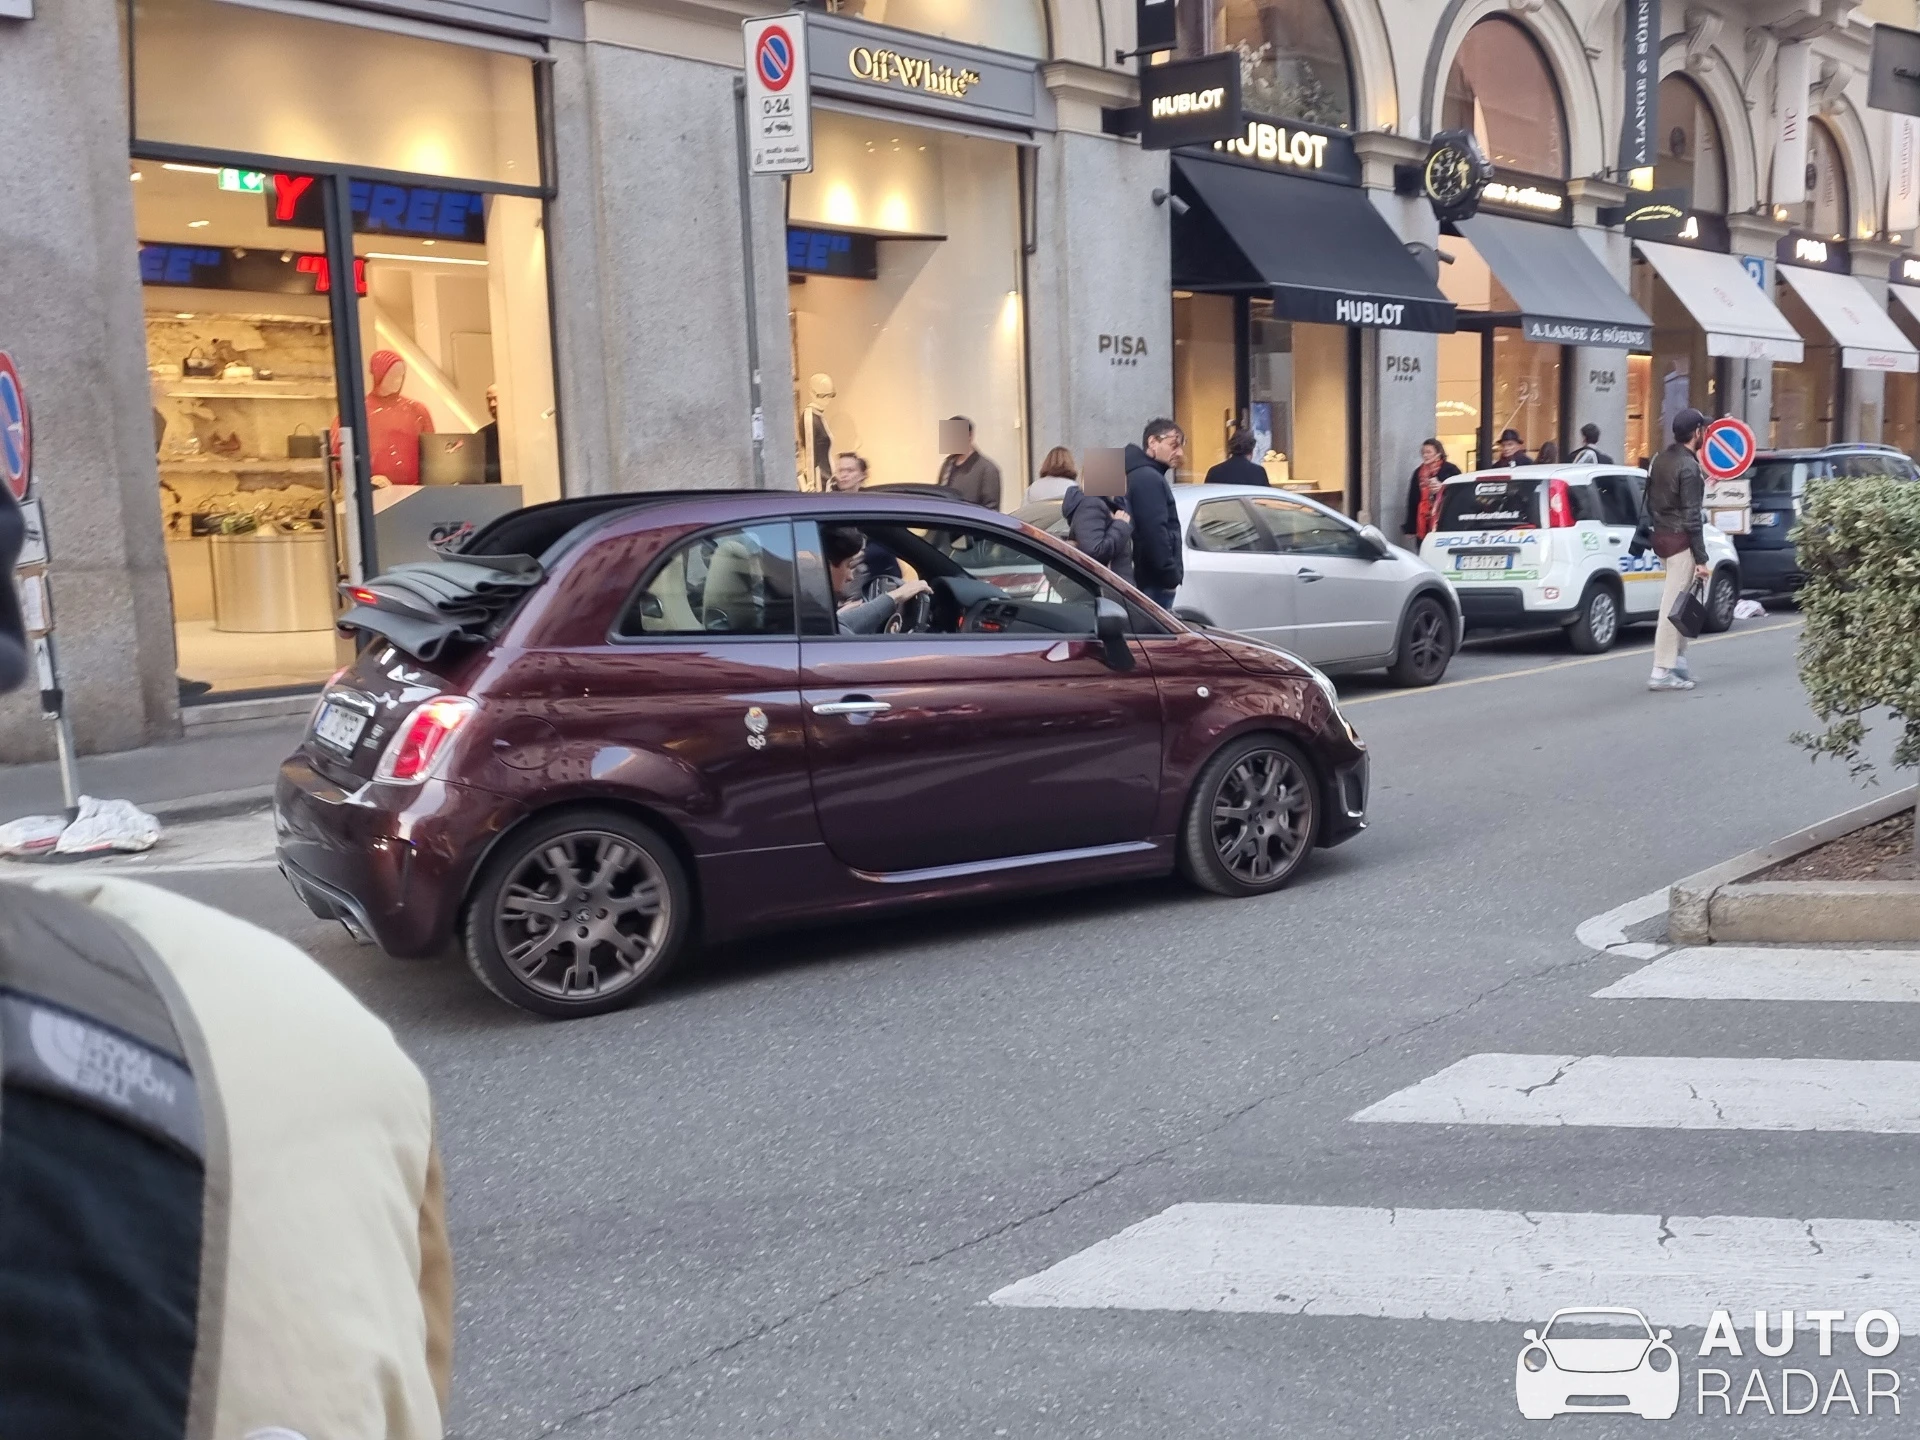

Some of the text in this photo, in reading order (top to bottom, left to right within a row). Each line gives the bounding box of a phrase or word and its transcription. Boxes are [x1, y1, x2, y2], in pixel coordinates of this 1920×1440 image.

[1635, 0, 1649, 55] SÖHN
[1636, 59, 1648, 74] &
[764, 98, 790, 115] 0-24
[1152, 87, 1224, 117] HUBLOT
[1783, 107, 1798, 143] IWC
[1214, 122, 1328, 168] UBLOT
[273, 174, 314, 221] Y
[1336, 299, 1405, 325] HUBLOT
[1098, 334, 1147, 356] PISA
[1386, 355, 1421, 373] PISA
[1590, 370, 1616, 385] PISA
